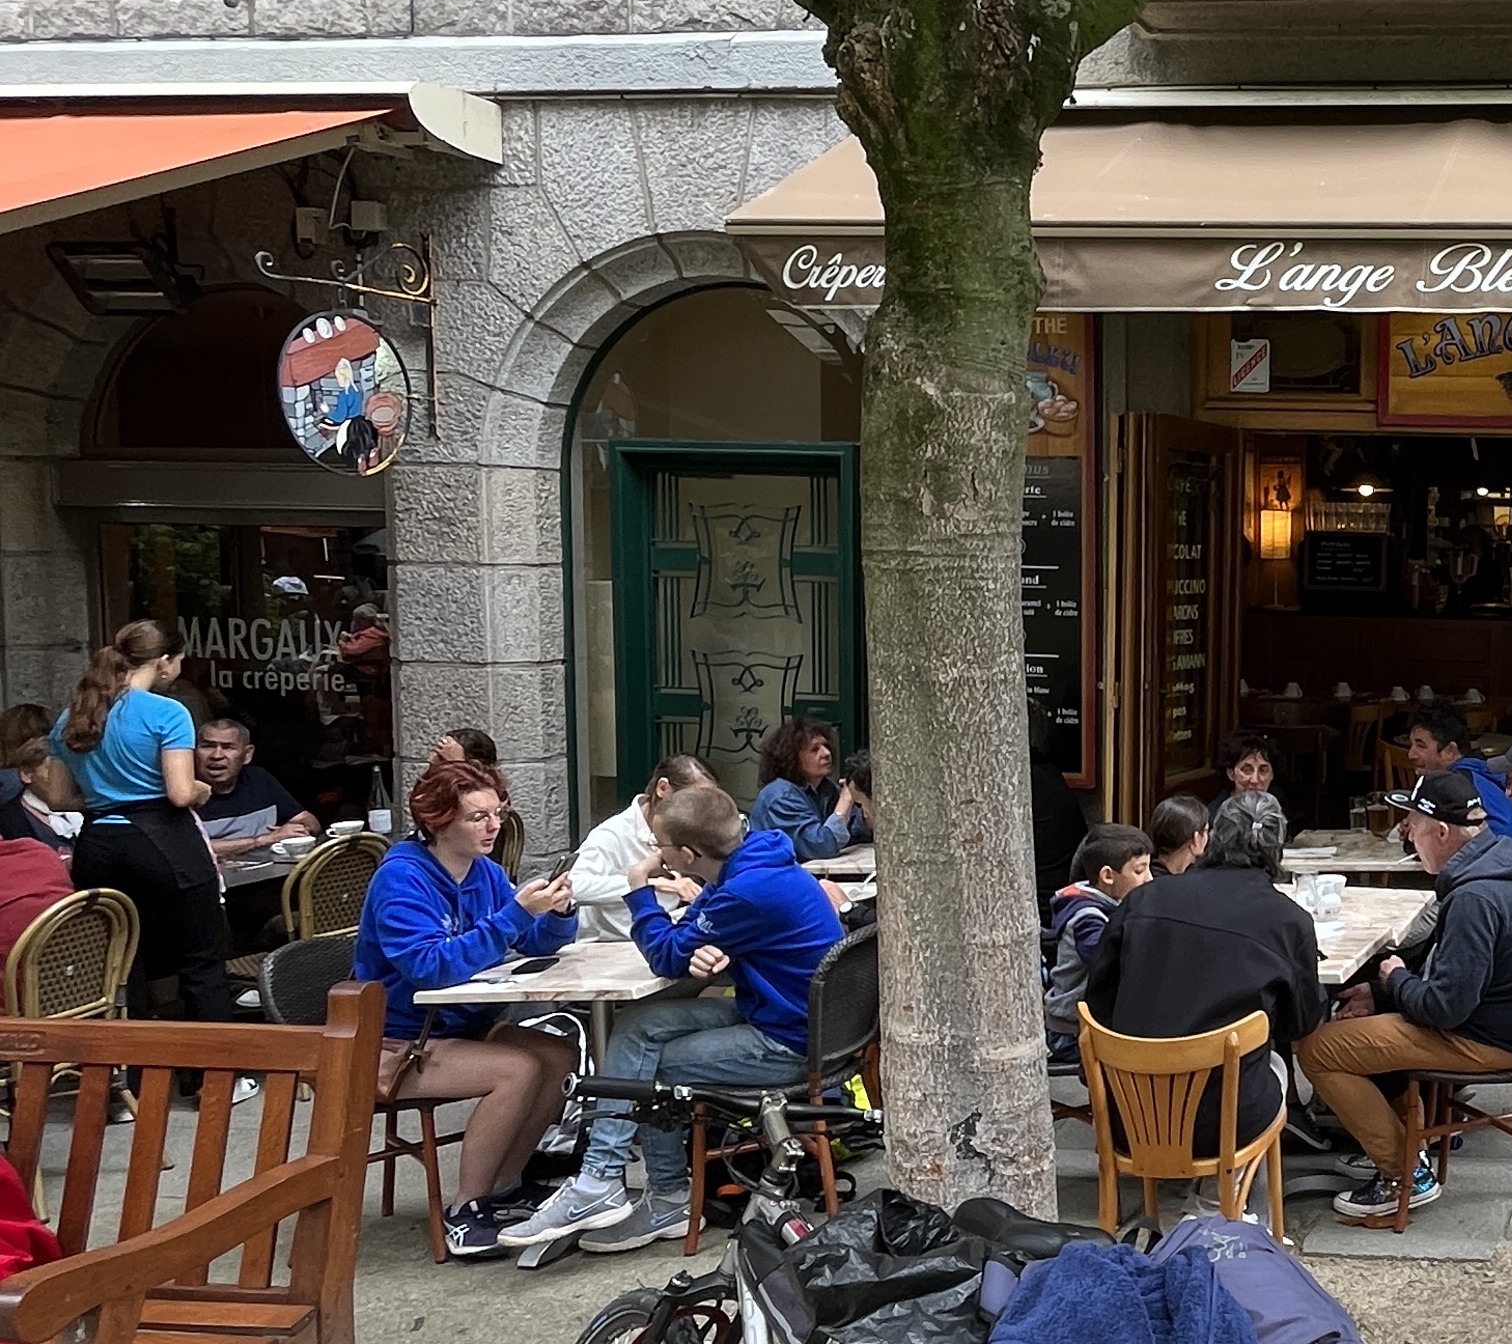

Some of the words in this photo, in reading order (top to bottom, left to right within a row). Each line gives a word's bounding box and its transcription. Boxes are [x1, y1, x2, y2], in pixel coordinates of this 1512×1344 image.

[783, 244, 886, 301] Crêper
[1214, 241, 1395, 307] L'ange
[178, 616, 342, 660] MARGAUX
[211, 660, 232, 688] la
[243, 664, 345, 696] crêperie
